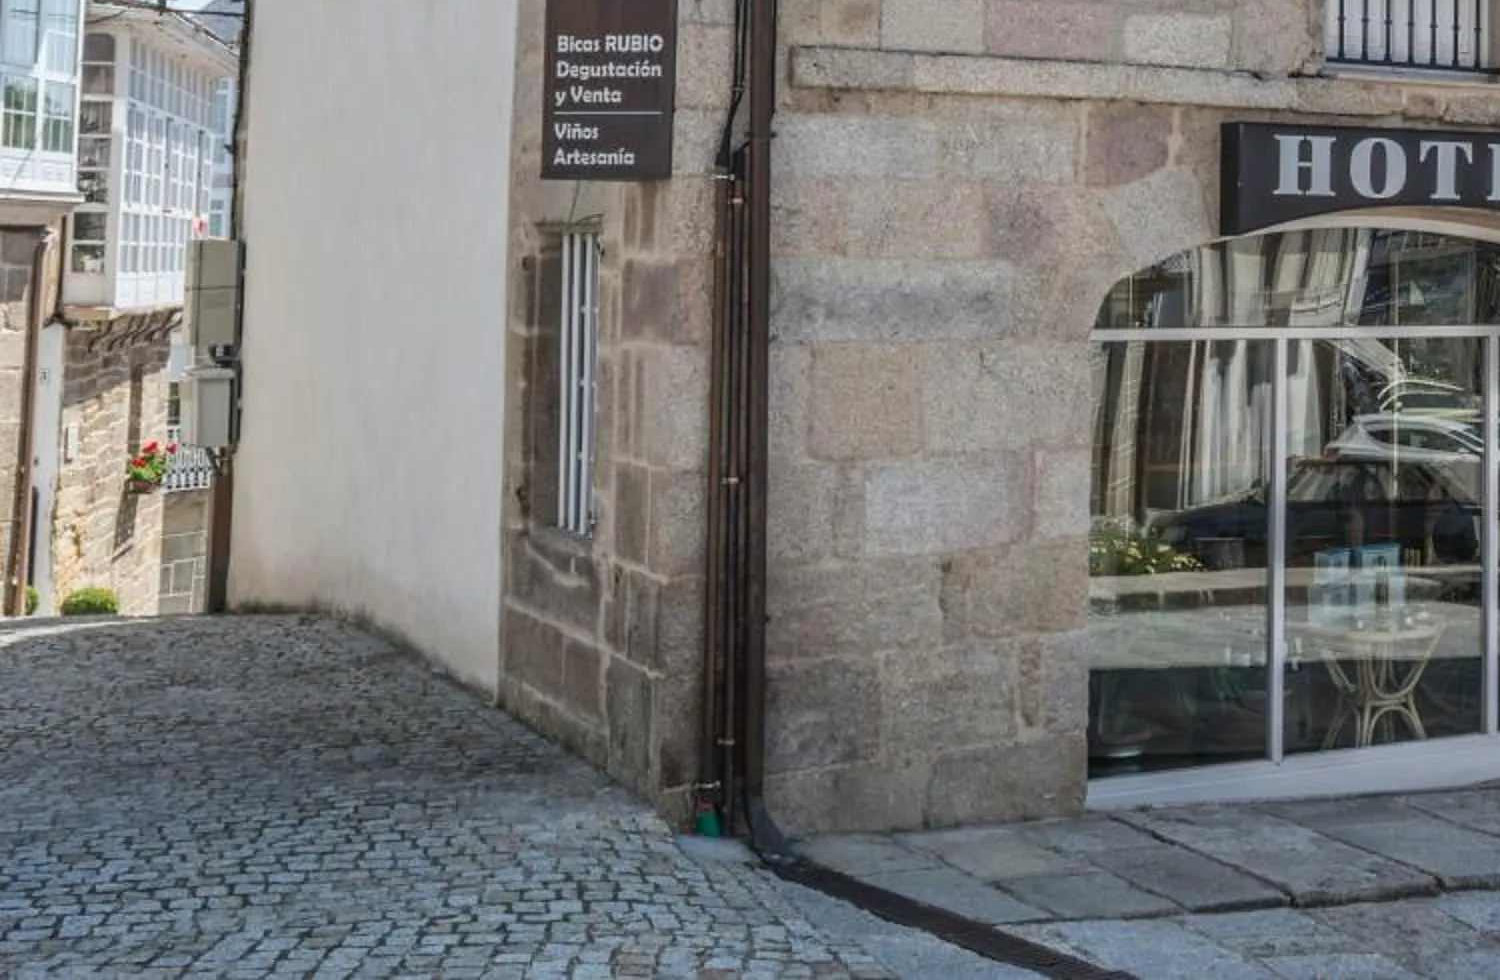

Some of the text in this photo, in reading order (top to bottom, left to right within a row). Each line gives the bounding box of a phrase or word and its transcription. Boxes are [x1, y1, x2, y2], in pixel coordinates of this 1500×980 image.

[557, 34, 664, 53] Bicas RUBIO
[556, 59, 662, 80] Degustación
[555, 85, 622, 107] y Venta
[554, 123, 600, 140] Viños
[553, 147, 635, 165] Artesanía
